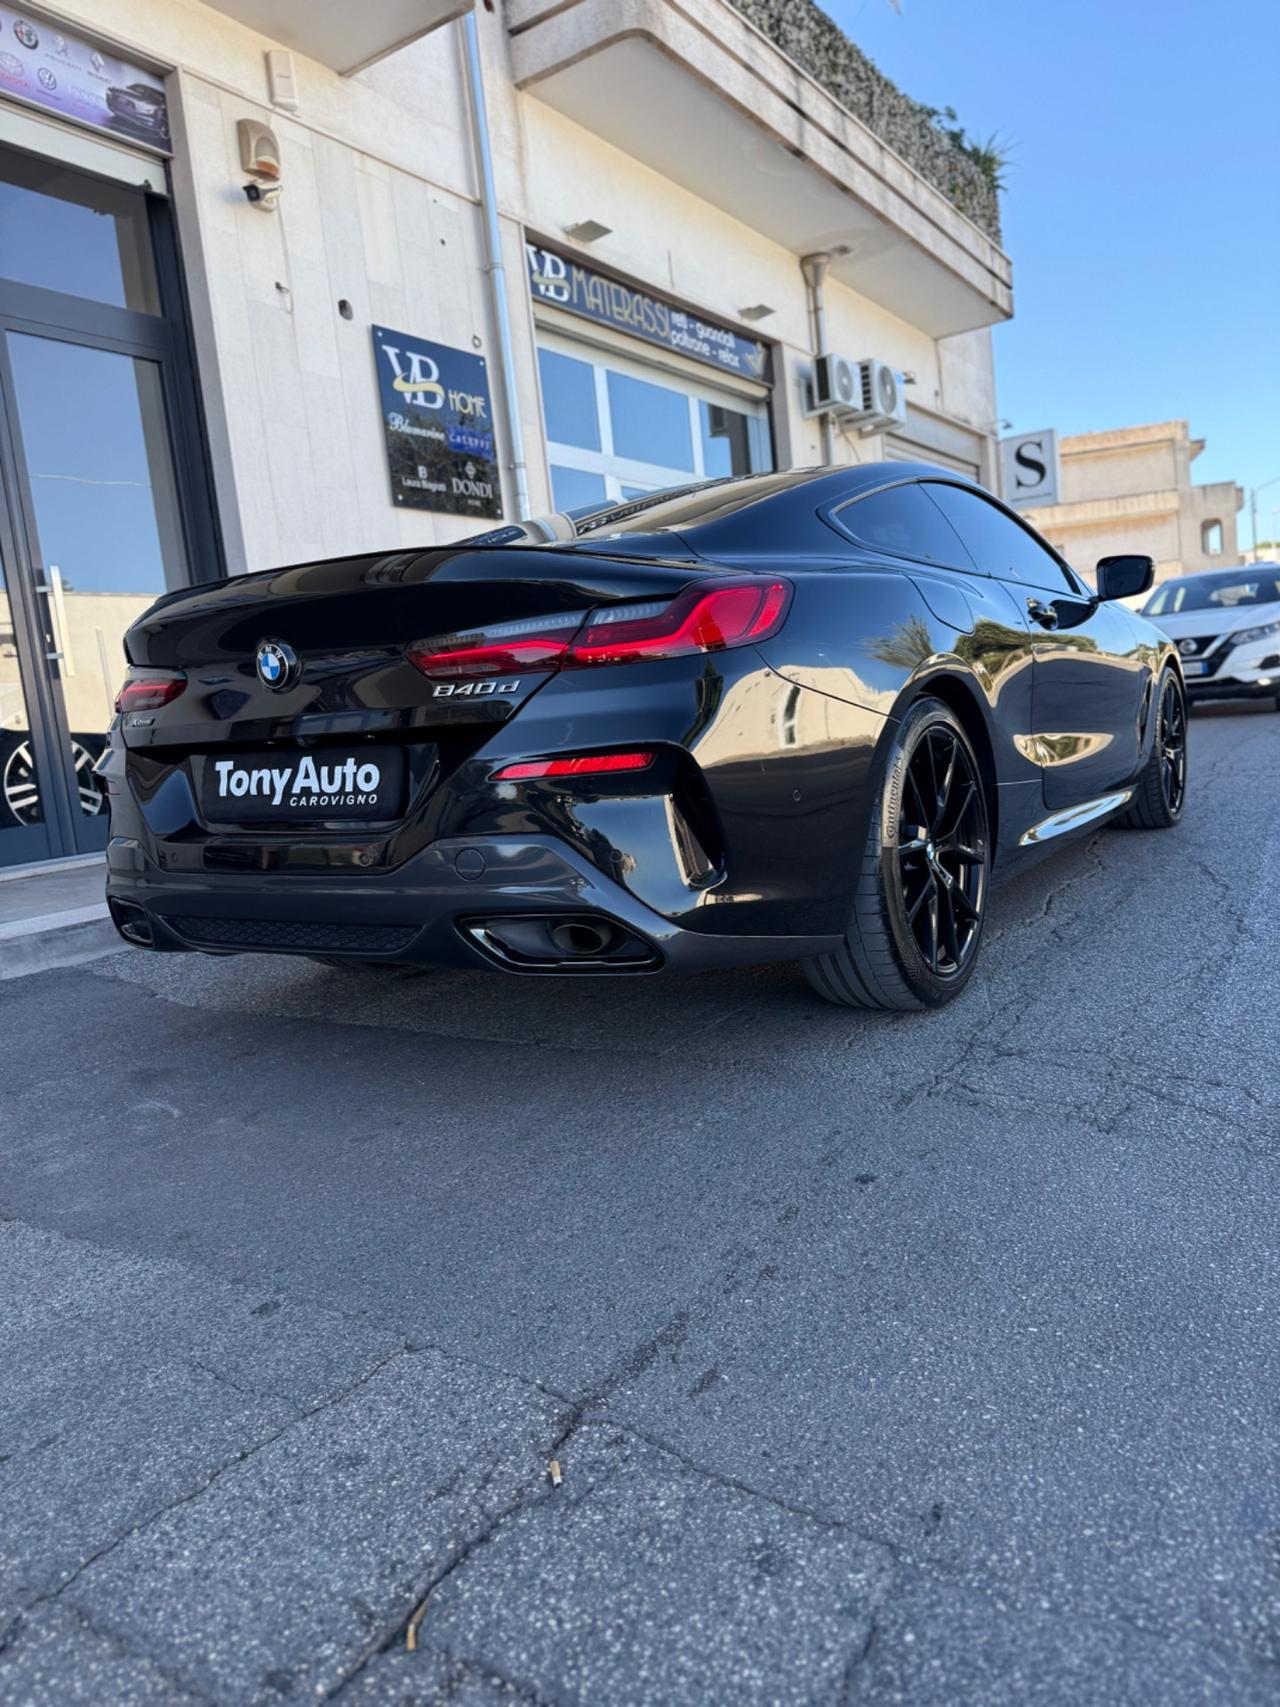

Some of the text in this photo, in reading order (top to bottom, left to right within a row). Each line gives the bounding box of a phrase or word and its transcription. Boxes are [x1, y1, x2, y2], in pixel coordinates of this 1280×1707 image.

[526, 245, 671, 339] VB MATERASSI
[670, 329, 711, 357] poltrone
[717, 348, 740, 368] relax
[382, 345, 487, 418] VB HOME
[1015, 441, 1046, 489] S
[453, 478, 493, 498] DONDI
[432, 679, 521, 699] 840d
[289, 793, 379, 807] CAROVIGNO
[886, 764, 902, 838] Continental
